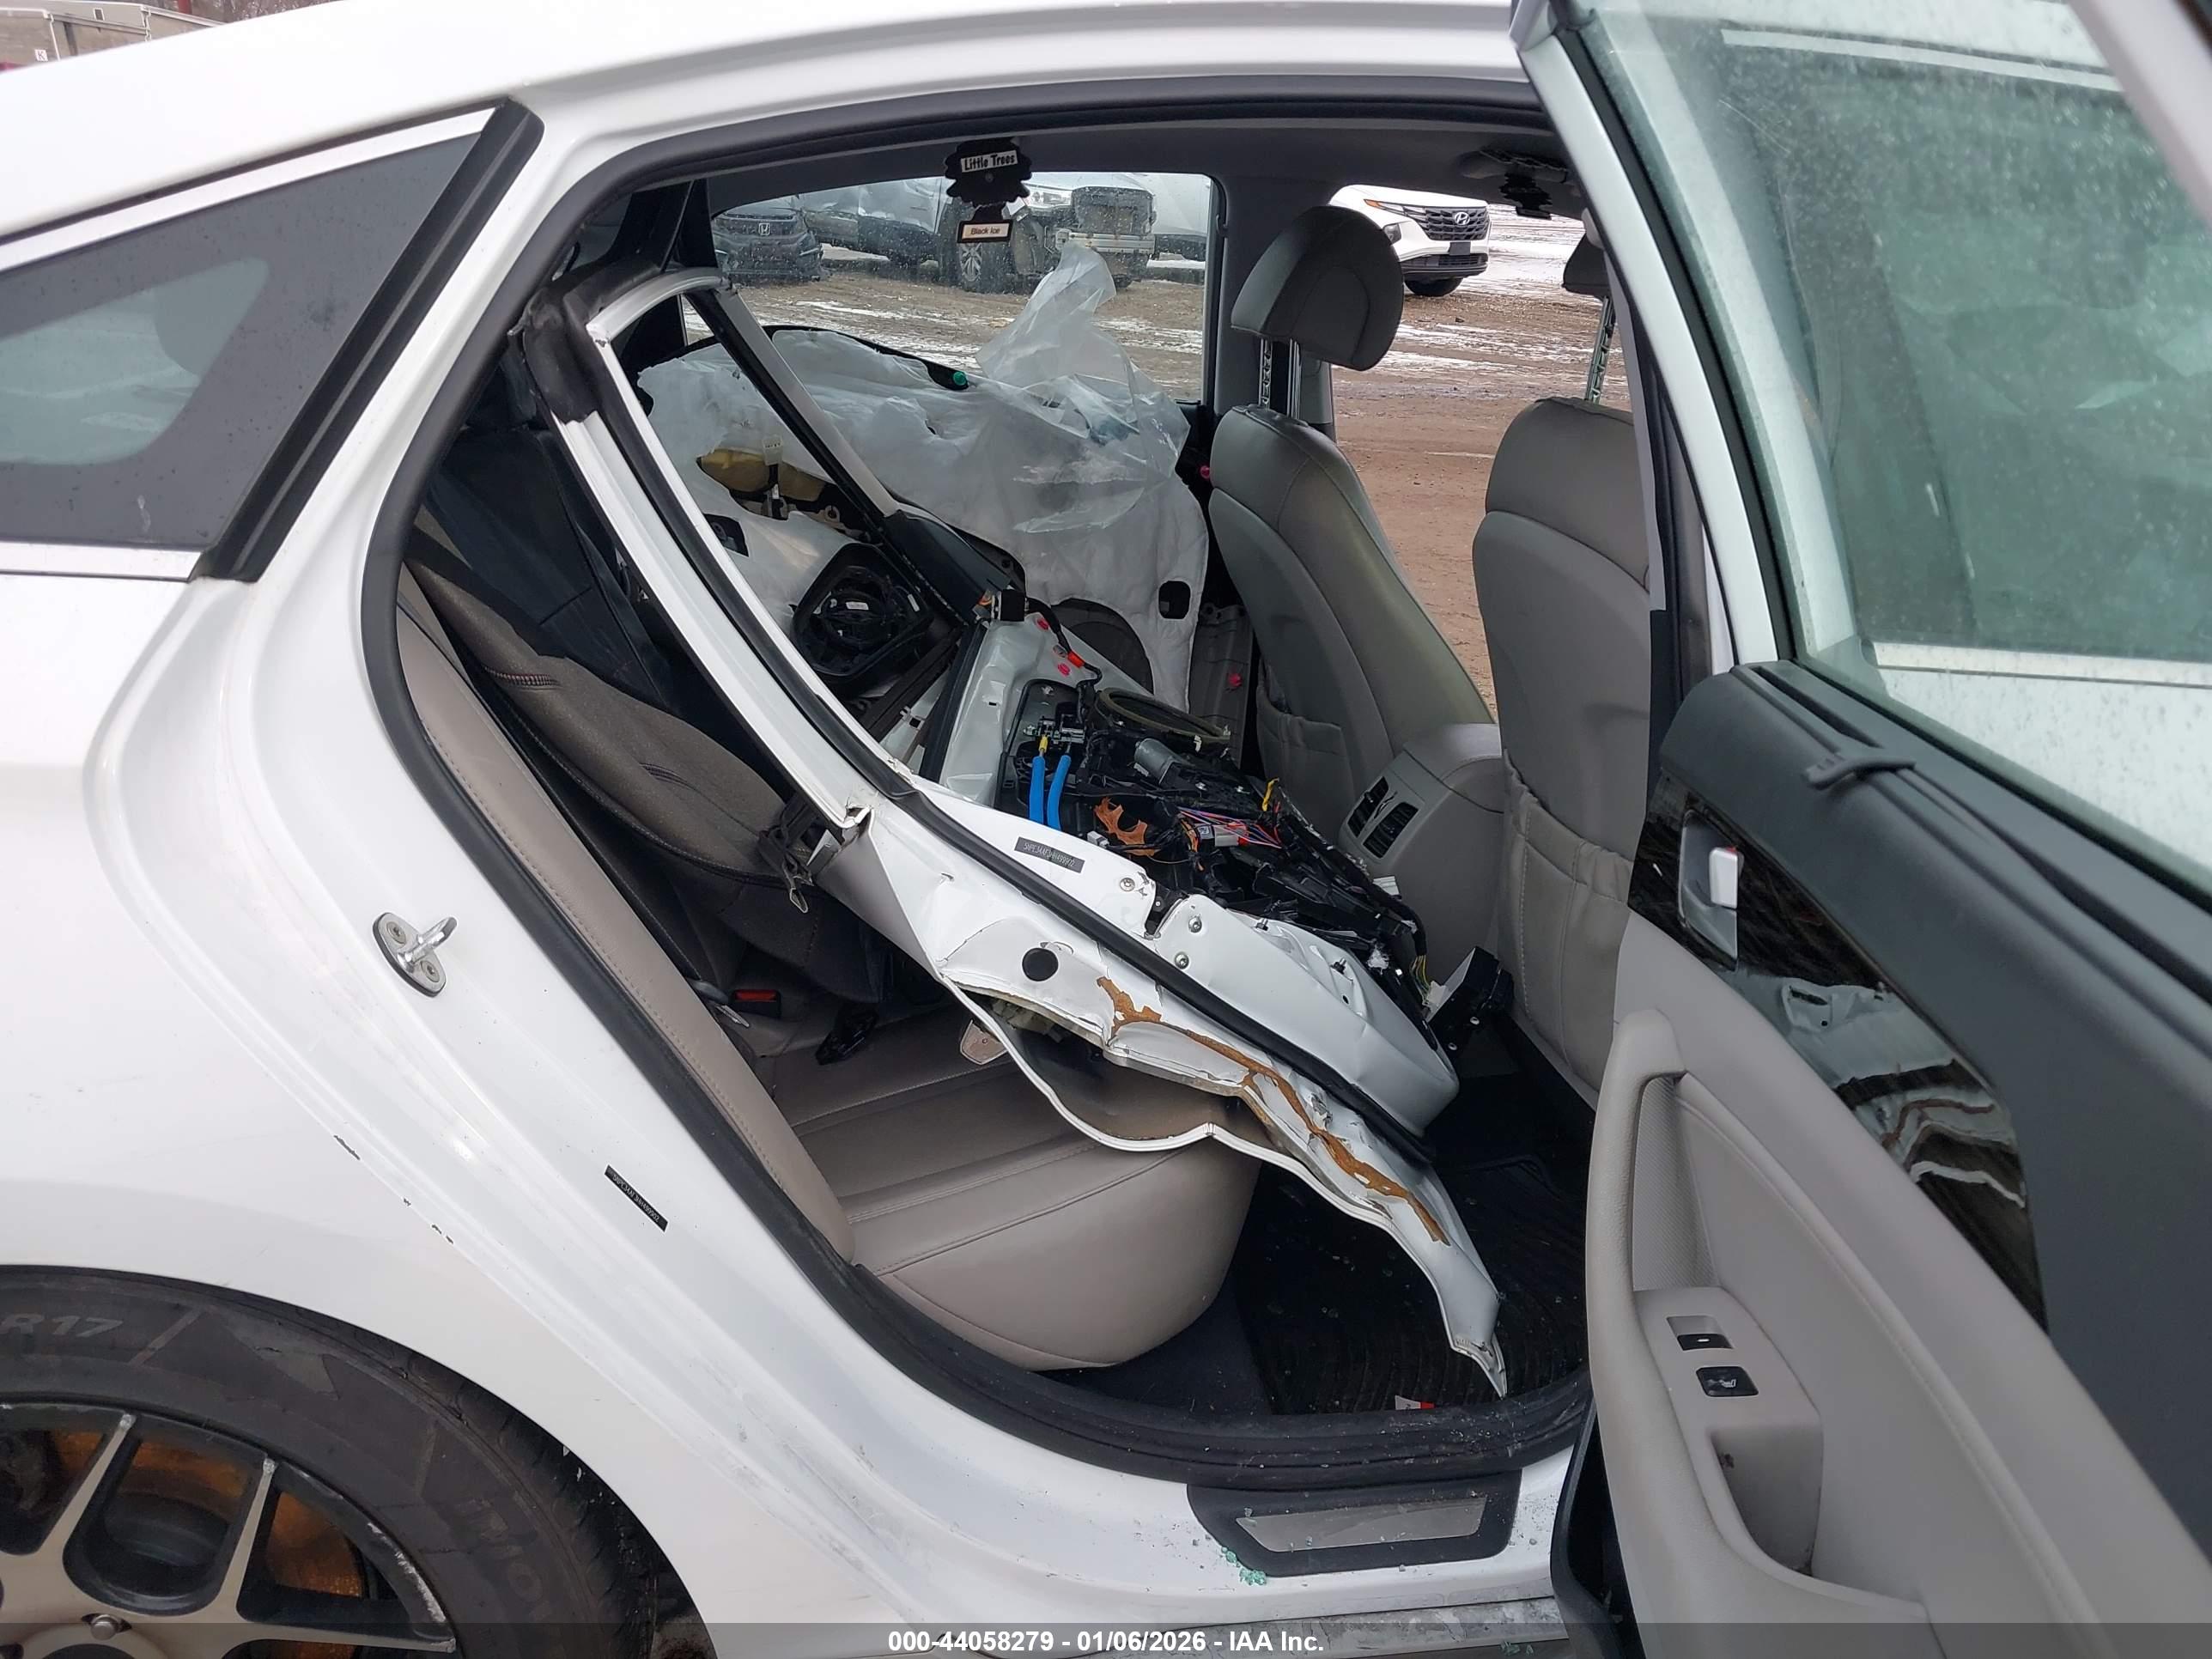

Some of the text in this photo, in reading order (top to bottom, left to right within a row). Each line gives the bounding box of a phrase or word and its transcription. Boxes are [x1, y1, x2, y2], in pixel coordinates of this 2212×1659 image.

[963, 153, 1015, 170] Little Trees
[0, 1313, 125, 1338] R17
